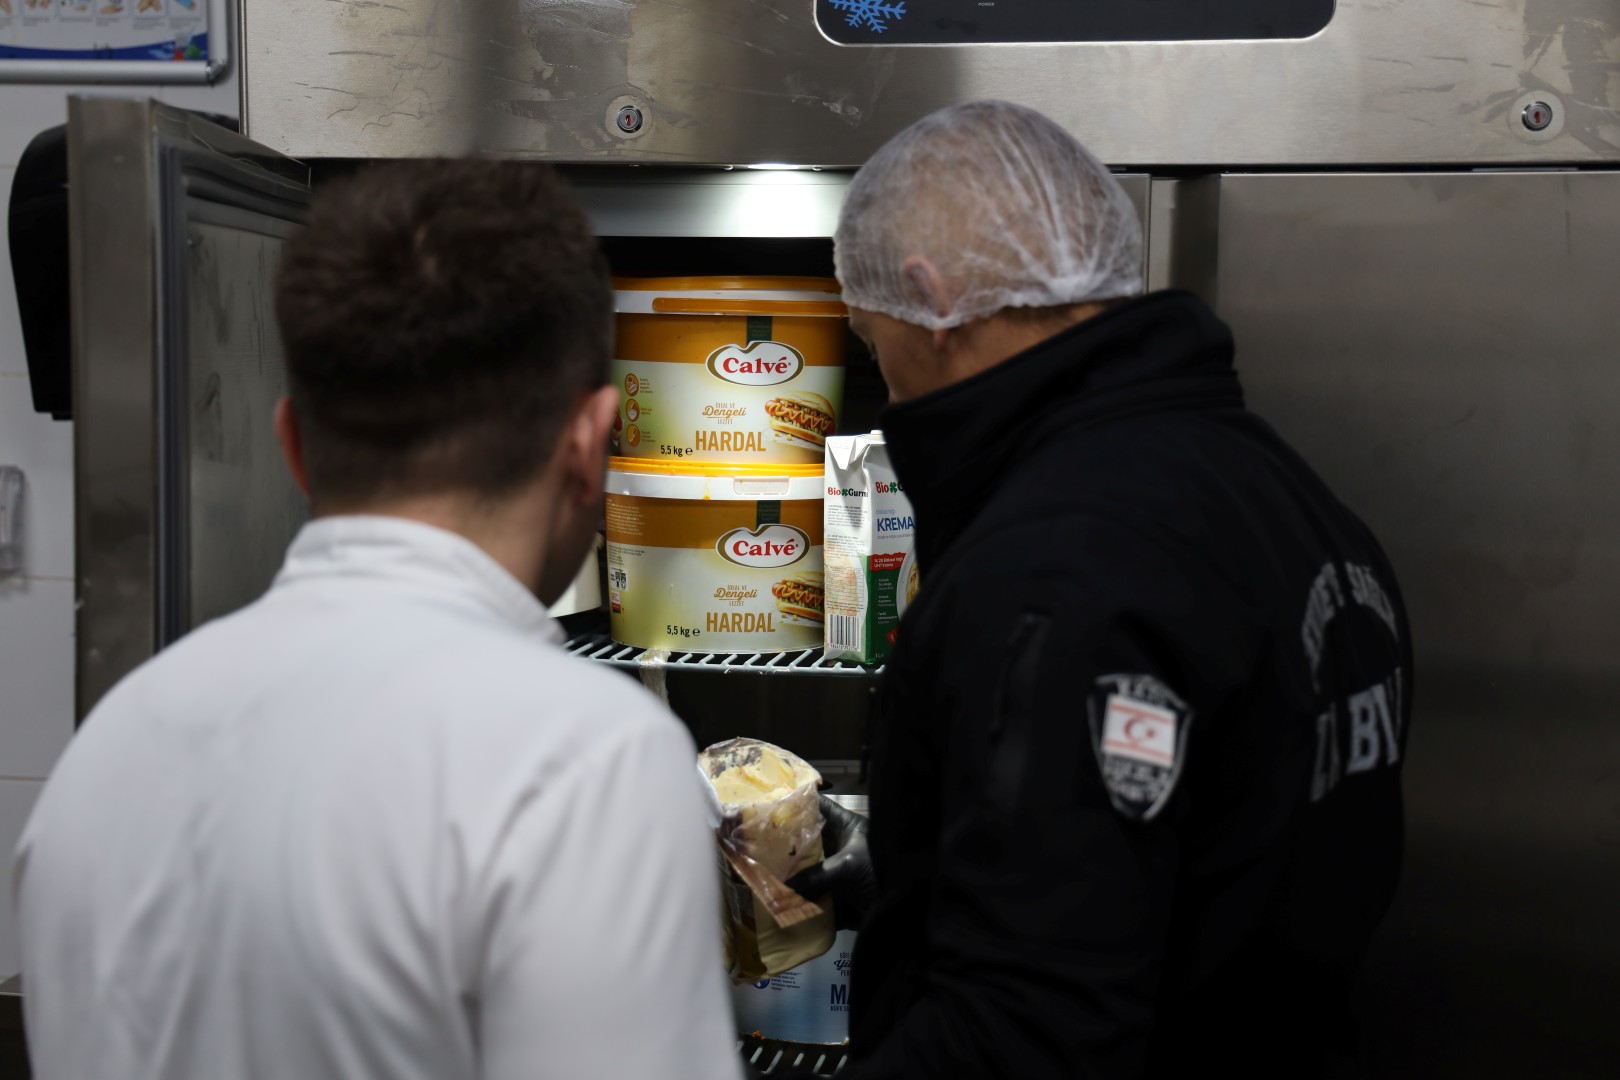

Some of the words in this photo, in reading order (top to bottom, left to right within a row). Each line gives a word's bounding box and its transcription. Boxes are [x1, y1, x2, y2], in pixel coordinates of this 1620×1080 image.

[722, 356, 788, 374] Calvé
[702, 405, 747, 419] Dengeli
[695, 430, 766, 452] HARDAL
[660, 444, 672, 455] 5,5
[673, 445, 683, 457] kg
[877, 516, 916, 532] KREMA
[732, 538, 795, 556] Calvé
[713, 587, 758, 601] Dengeli
[706, 612, 776, 633] HARDAL
[667, 625, 678, 635] 5,5
[680, 626, 690, 638] kg
